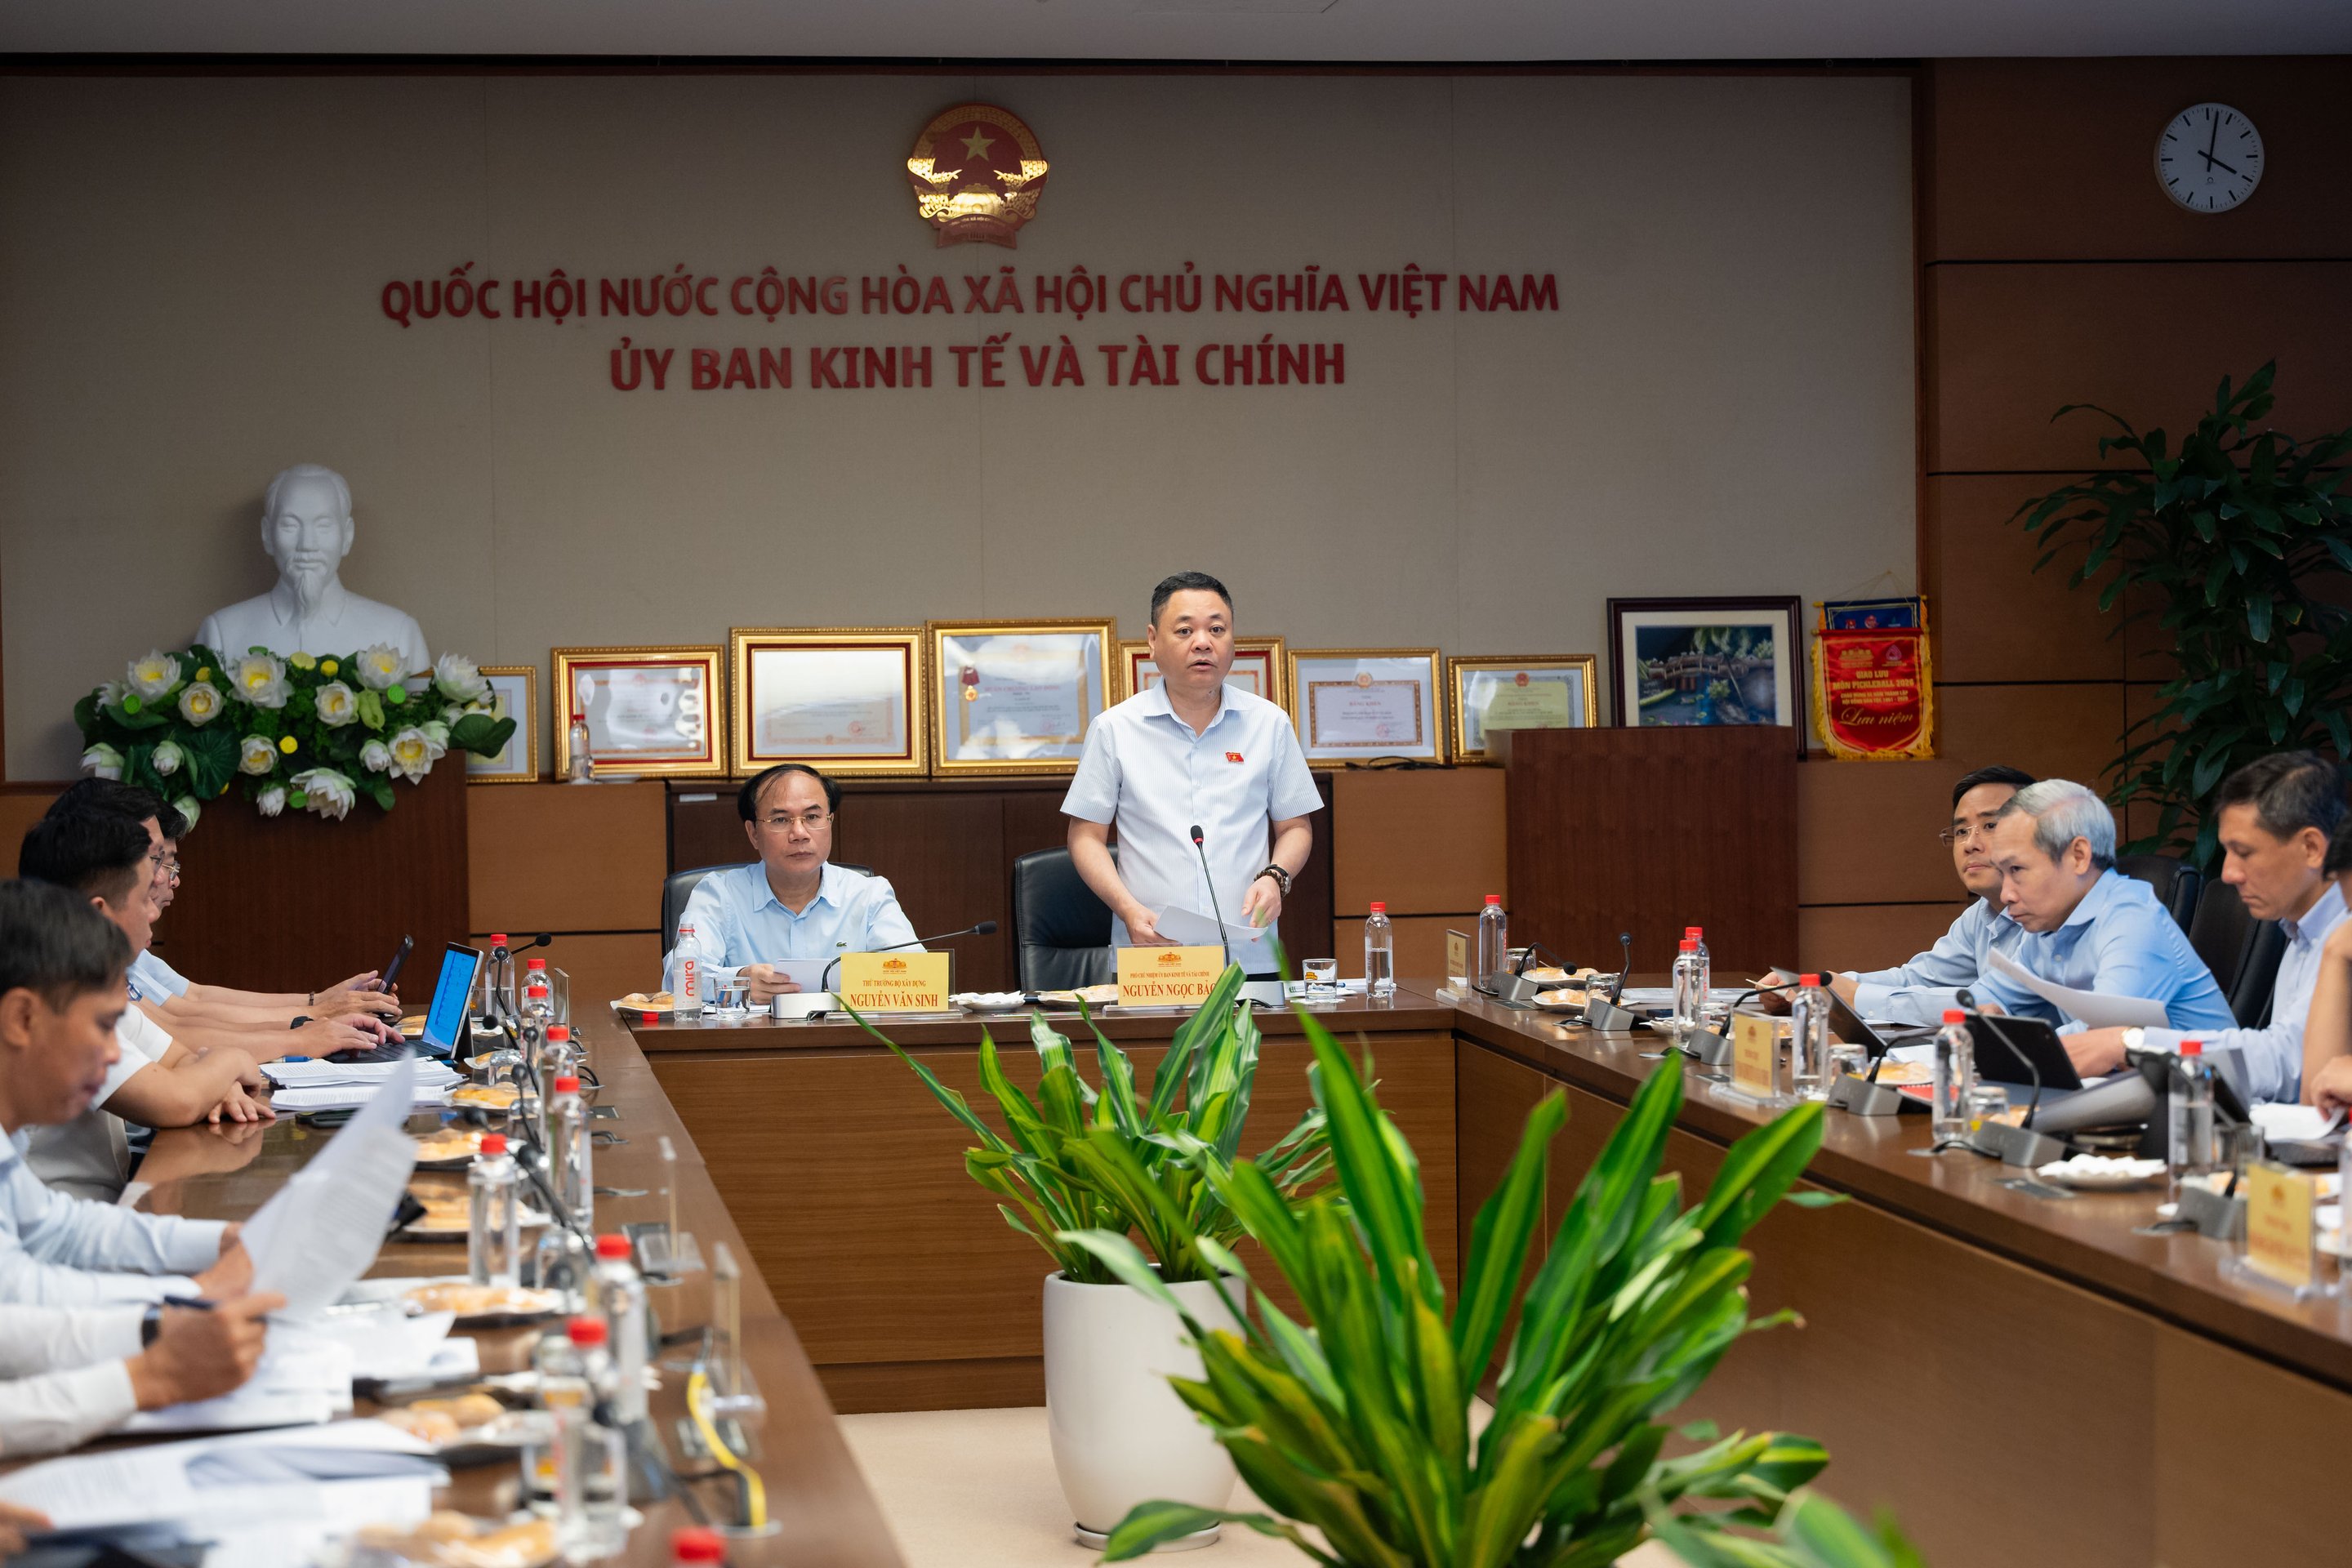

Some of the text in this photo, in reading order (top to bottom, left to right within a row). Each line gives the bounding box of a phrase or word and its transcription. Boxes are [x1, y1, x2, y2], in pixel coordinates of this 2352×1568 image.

[384, 261, 1558, 327] QUỐC HỘI NƯỚC CỘNG HÒA XÃ HỘI CHỦ NGHĨA VIỆT NAM
[612, 332, 1343, 390] ỦY BAN KINH TẾ VÀ TÀI CHÍNH
[1879, 711, 1913, 726] niệm
[685, 960, 694, 997] mira
[1123, 981, 1165, 997] NGUYỄN
[1166, 983, 1195, 999] NGỌC
[850, 990, 938, 1007] NGUYỄN VĂN SINH
